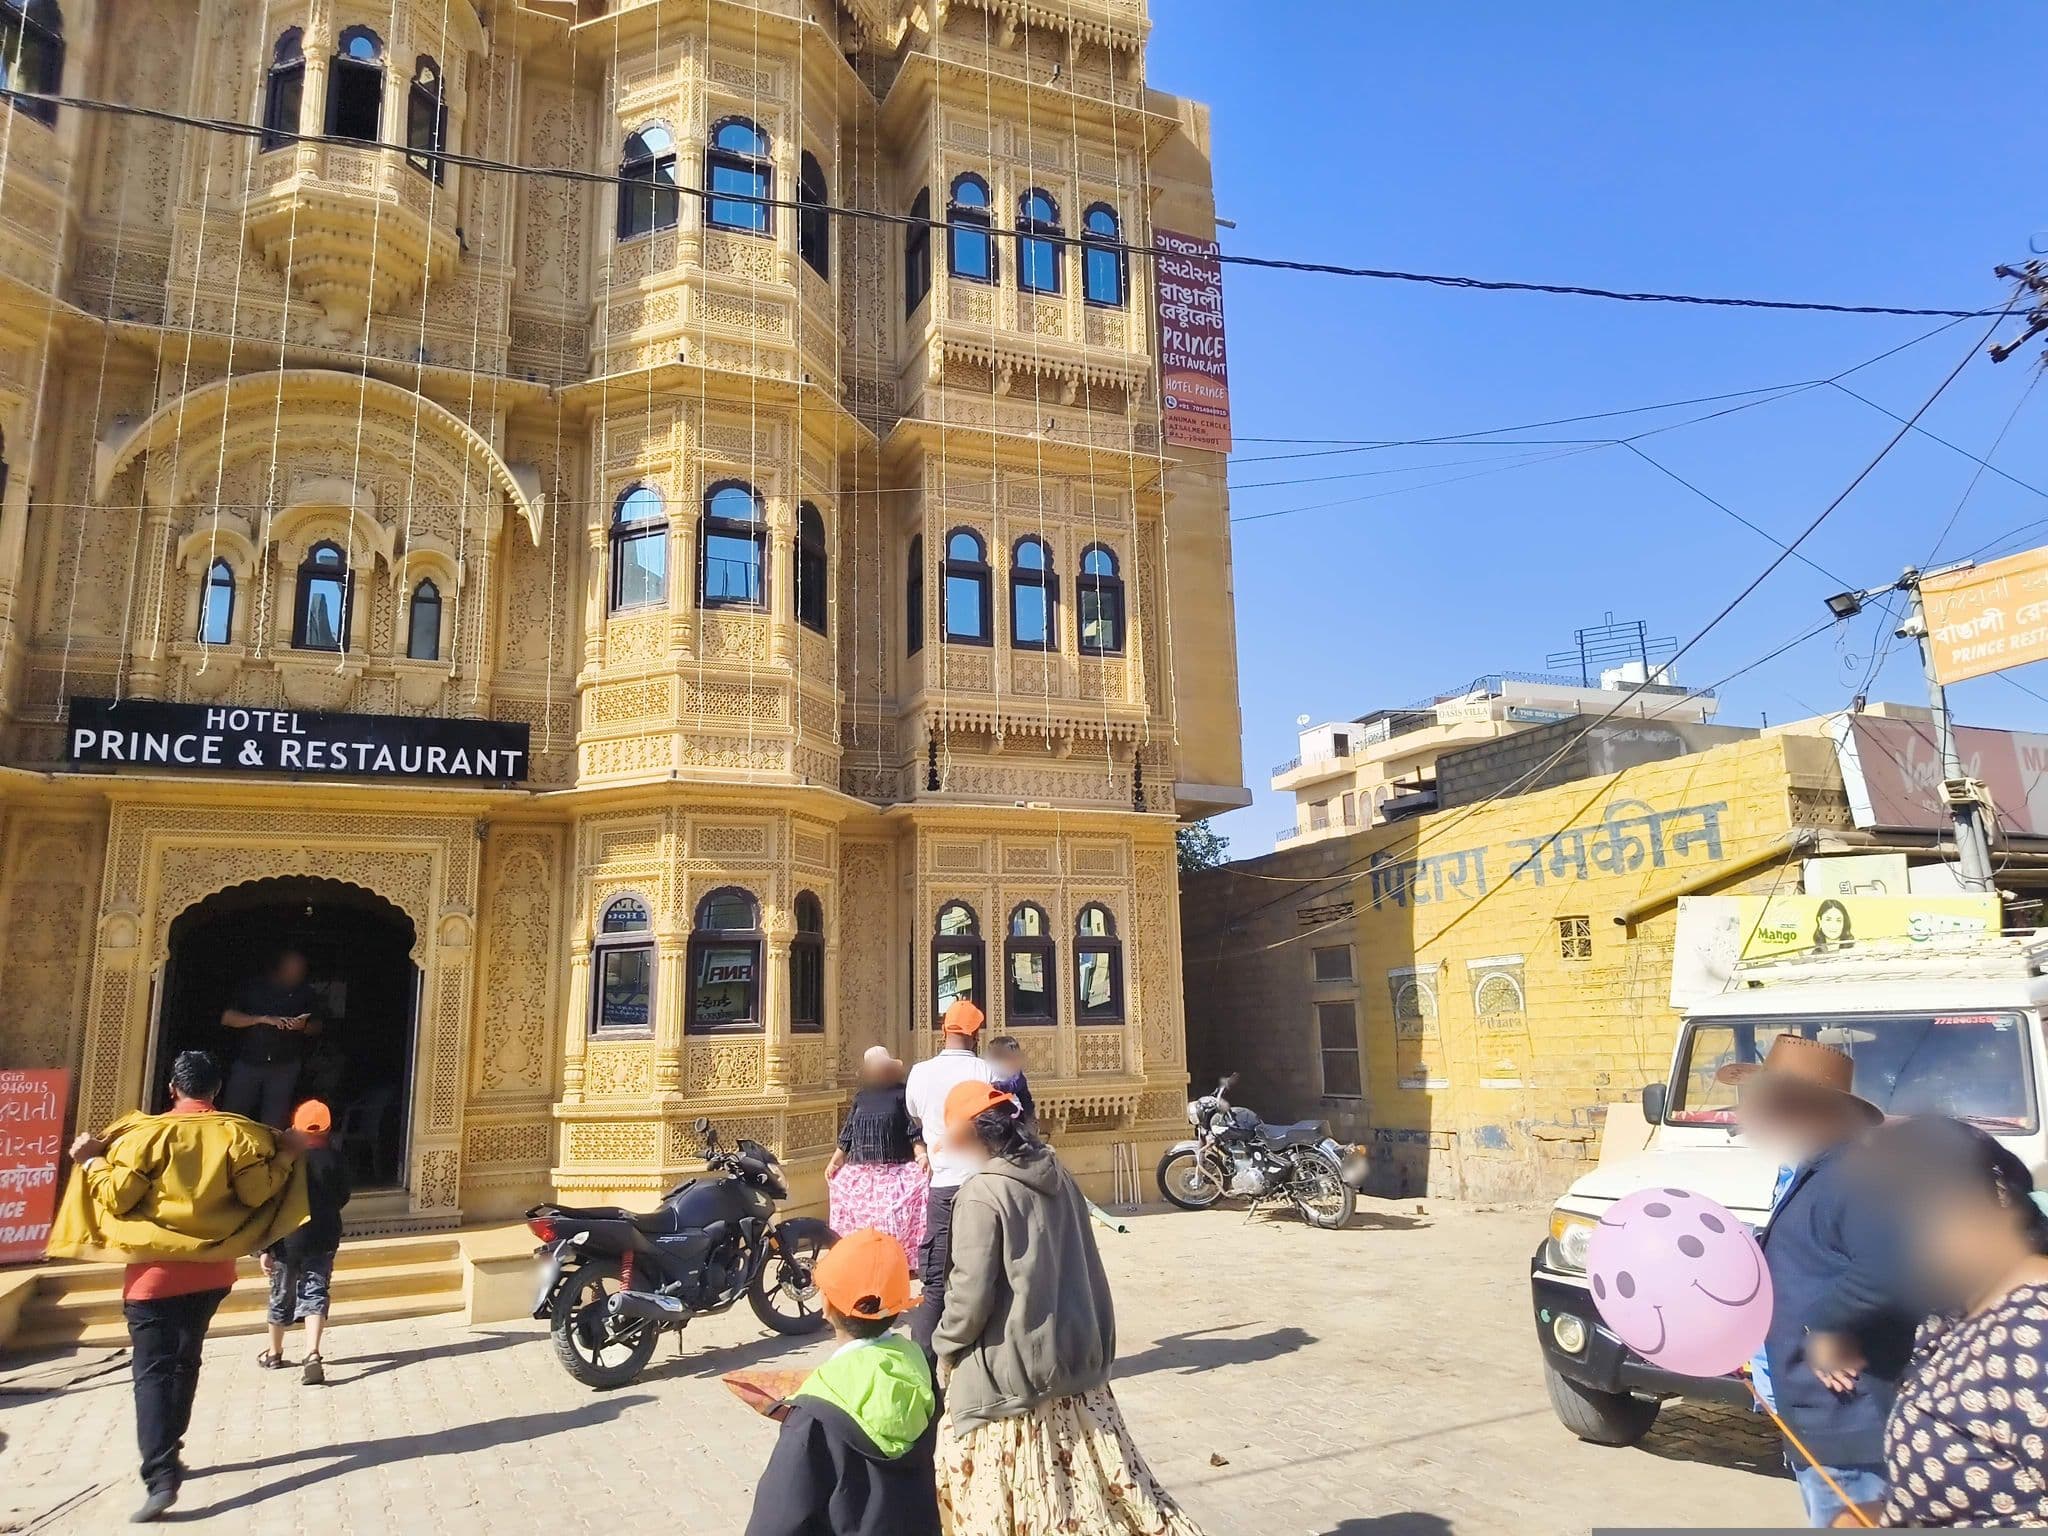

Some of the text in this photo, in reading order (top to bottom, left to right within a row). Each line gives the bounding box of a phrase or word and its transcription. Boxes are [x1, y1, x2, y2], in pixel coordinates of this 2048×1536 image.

[1163, 326, 1225, 358] PRINCE
[1162, 352, 1226, 375] RESTAURANT
[1165, 377, 1225, 399] HOTEL PRINCE
[1951, 638, 2005, 664] PRINCE
[207, 708, 306, 735] HOTEL
[73, 729, 523, 777] PRINCE & RESTAURANT
[1505, 798, 1727, 887] नमकीन
[1758, 927, 1797, 943] Mango
[1, 1072, 25, 1082] Giri
